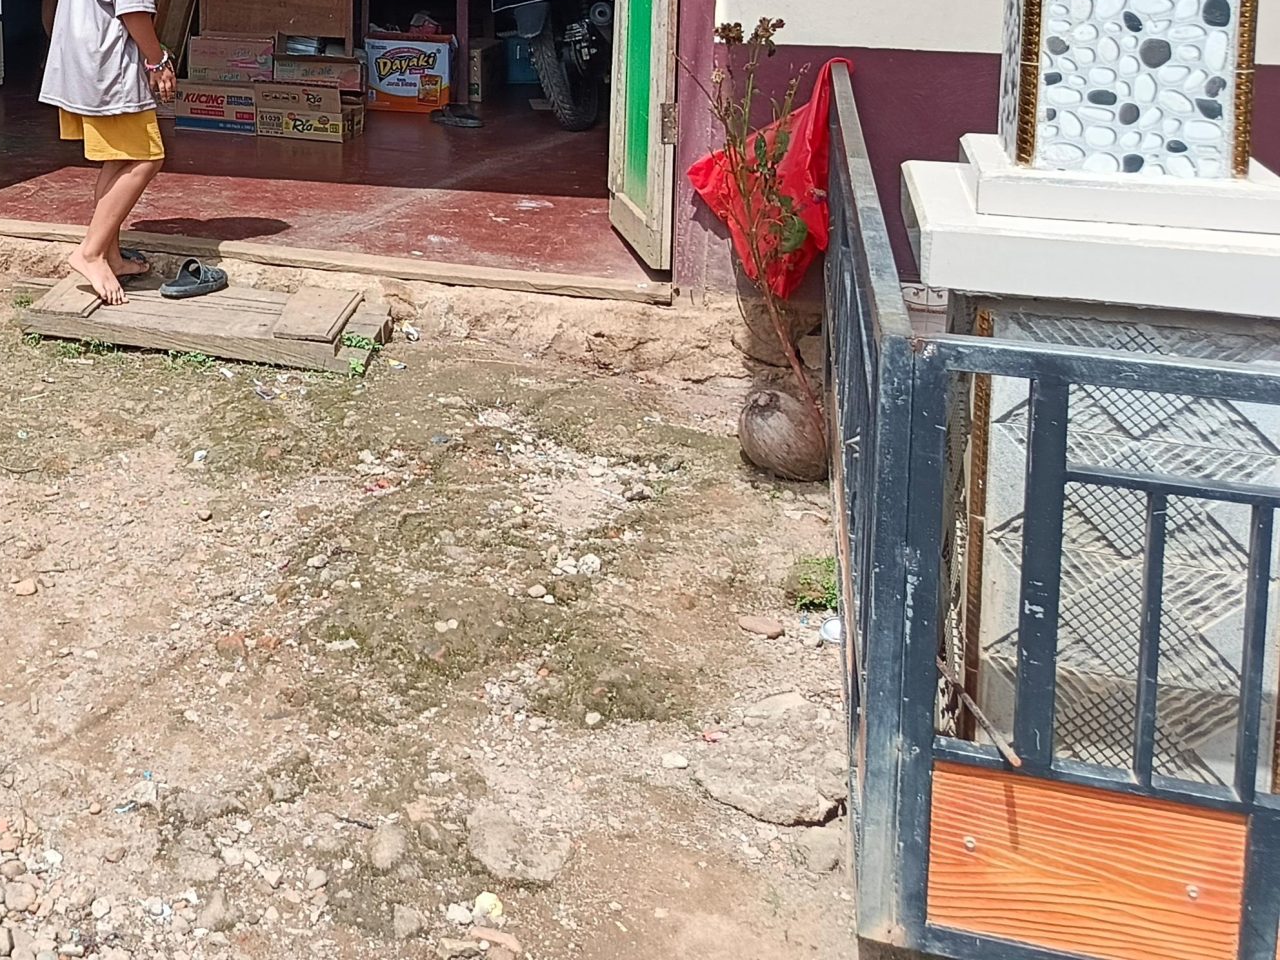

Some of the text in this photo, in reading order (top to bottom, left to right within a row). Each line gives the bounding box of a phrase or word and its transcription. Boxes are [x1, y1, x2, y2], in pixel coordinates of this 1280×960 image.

[376, 52, 435, 76] Dayaki
[183, 92, 225, 106] KUCING
[291, 118, 313, 133] Rio
